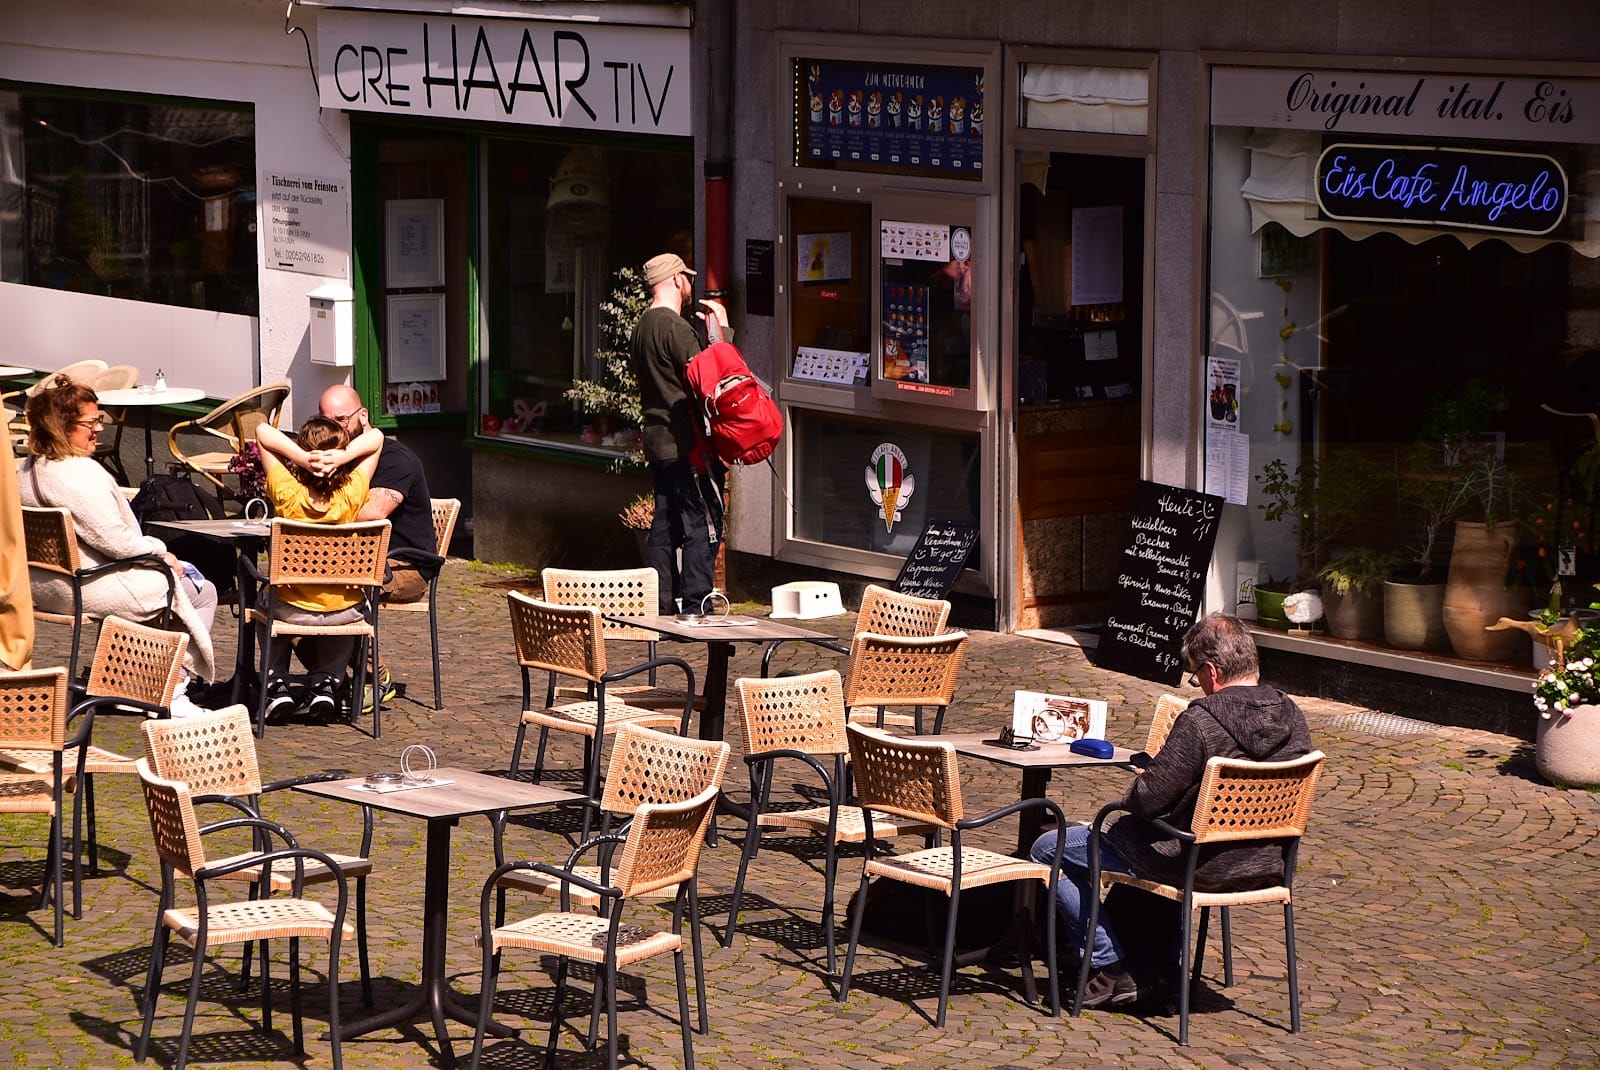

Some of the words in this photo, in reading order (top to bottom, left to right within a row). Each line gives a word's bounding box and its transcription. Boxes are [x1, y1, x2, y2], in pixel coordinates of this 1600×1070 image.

[864, 72, 879, 87] ZUM
[883, 73, 924, 88] MITNEHMEN
[1286, 72, 1425, 129] Original
[1436, 81, 1504, 120] ital.
[1524, 81, 1575, 124] Eis
[302, 182, 313, 190] vom
[314, 180, 338, 192] Feinsten
[1440, 165, 1558, 221] Angelo
[1158, 494, 1194, 516] Heute
[1131, 515, 1177, 536] Heidelbeer
[1136, 533, 1170, 549] Becher
[1129, 634, 1156, 649] Becher
